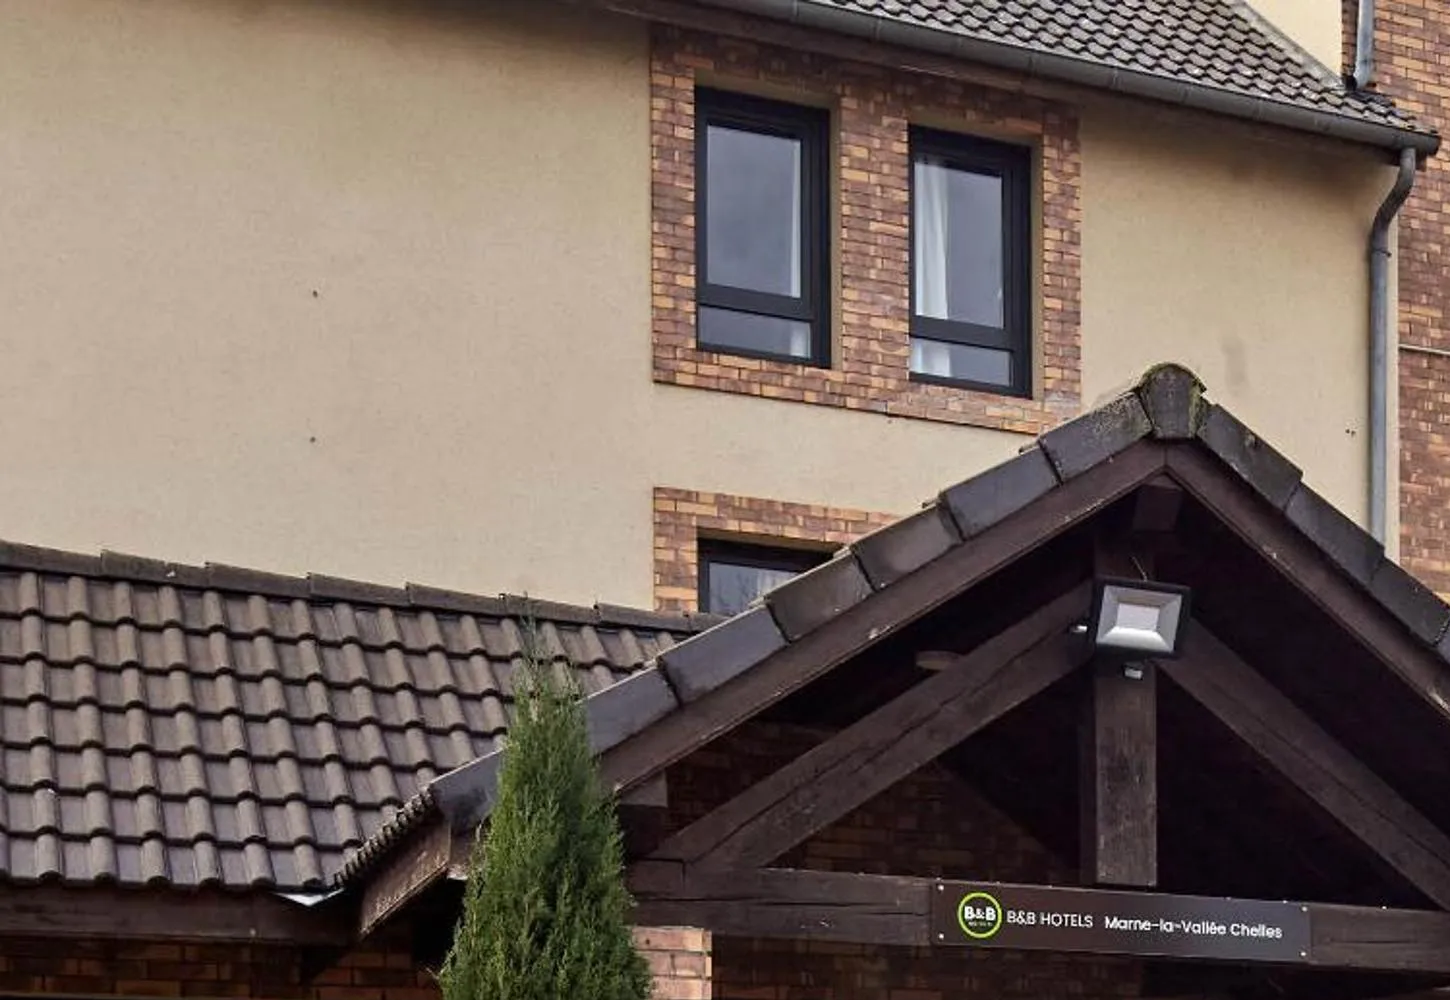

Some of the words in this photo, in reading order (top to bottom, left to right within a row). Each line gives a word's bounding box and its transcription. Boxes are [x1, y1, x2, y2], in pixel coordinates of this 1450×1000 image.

[964, 906, 996, 921] B&B
[1007, 910, 1036, 925] B&B
[1040, 912, 1094, 928] HOTELS
[1104, 915, 1226, 936] Marne-la-Vallée
[1229, 923, 1283, 939] Chelles
